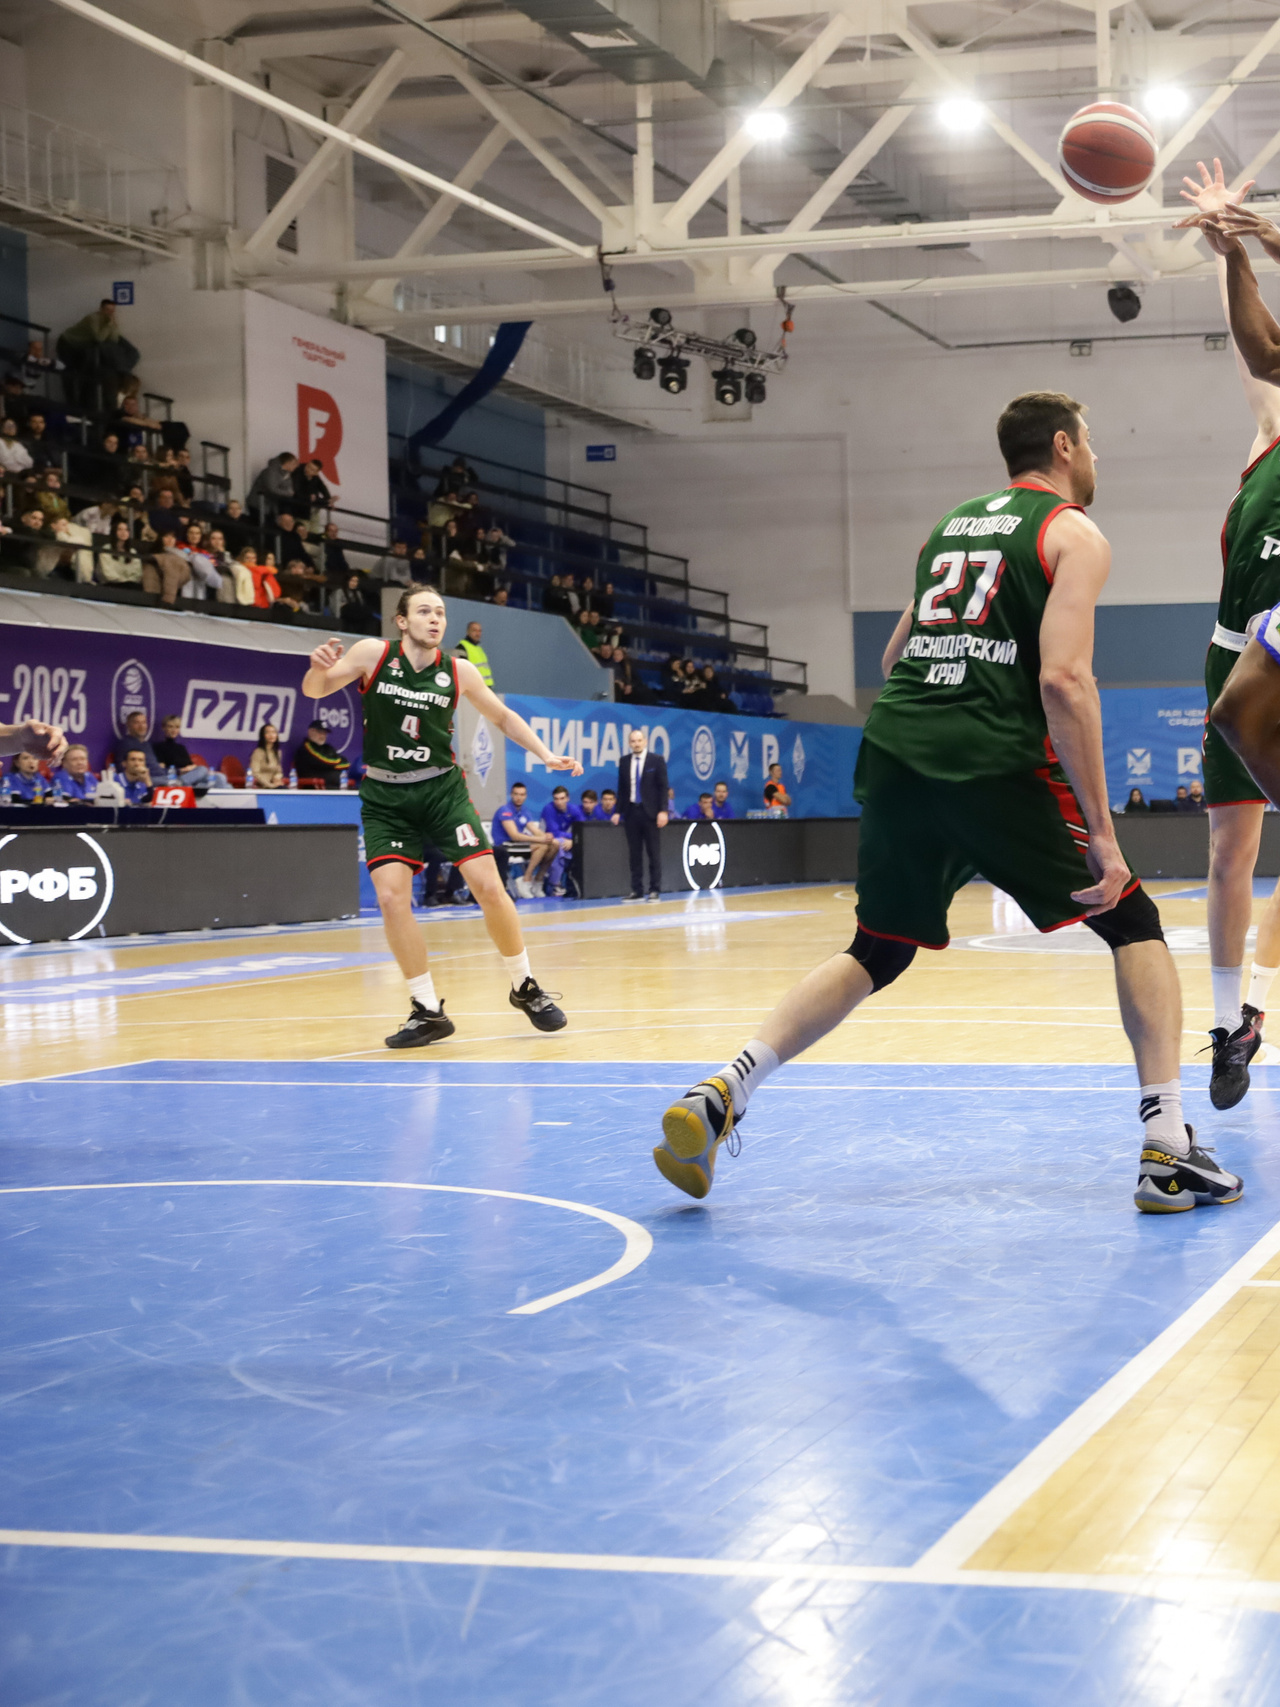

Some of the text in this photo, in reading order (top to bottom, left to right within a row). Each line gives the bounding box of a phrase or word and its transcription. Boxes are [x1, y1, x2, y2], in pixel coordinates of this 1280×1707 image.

[917, 550, 1007, 626] 27
[923, 659, 968, 686] КРАЙ
[376, 682, 451, 708] ЛОКОМОТИВ
[394, 699, 430, 711] КУБАНЬ
[400, 714, 421, 740] 4
[455, 823, 480, 847] 4
[0, 866, 97, 903] РФБ
